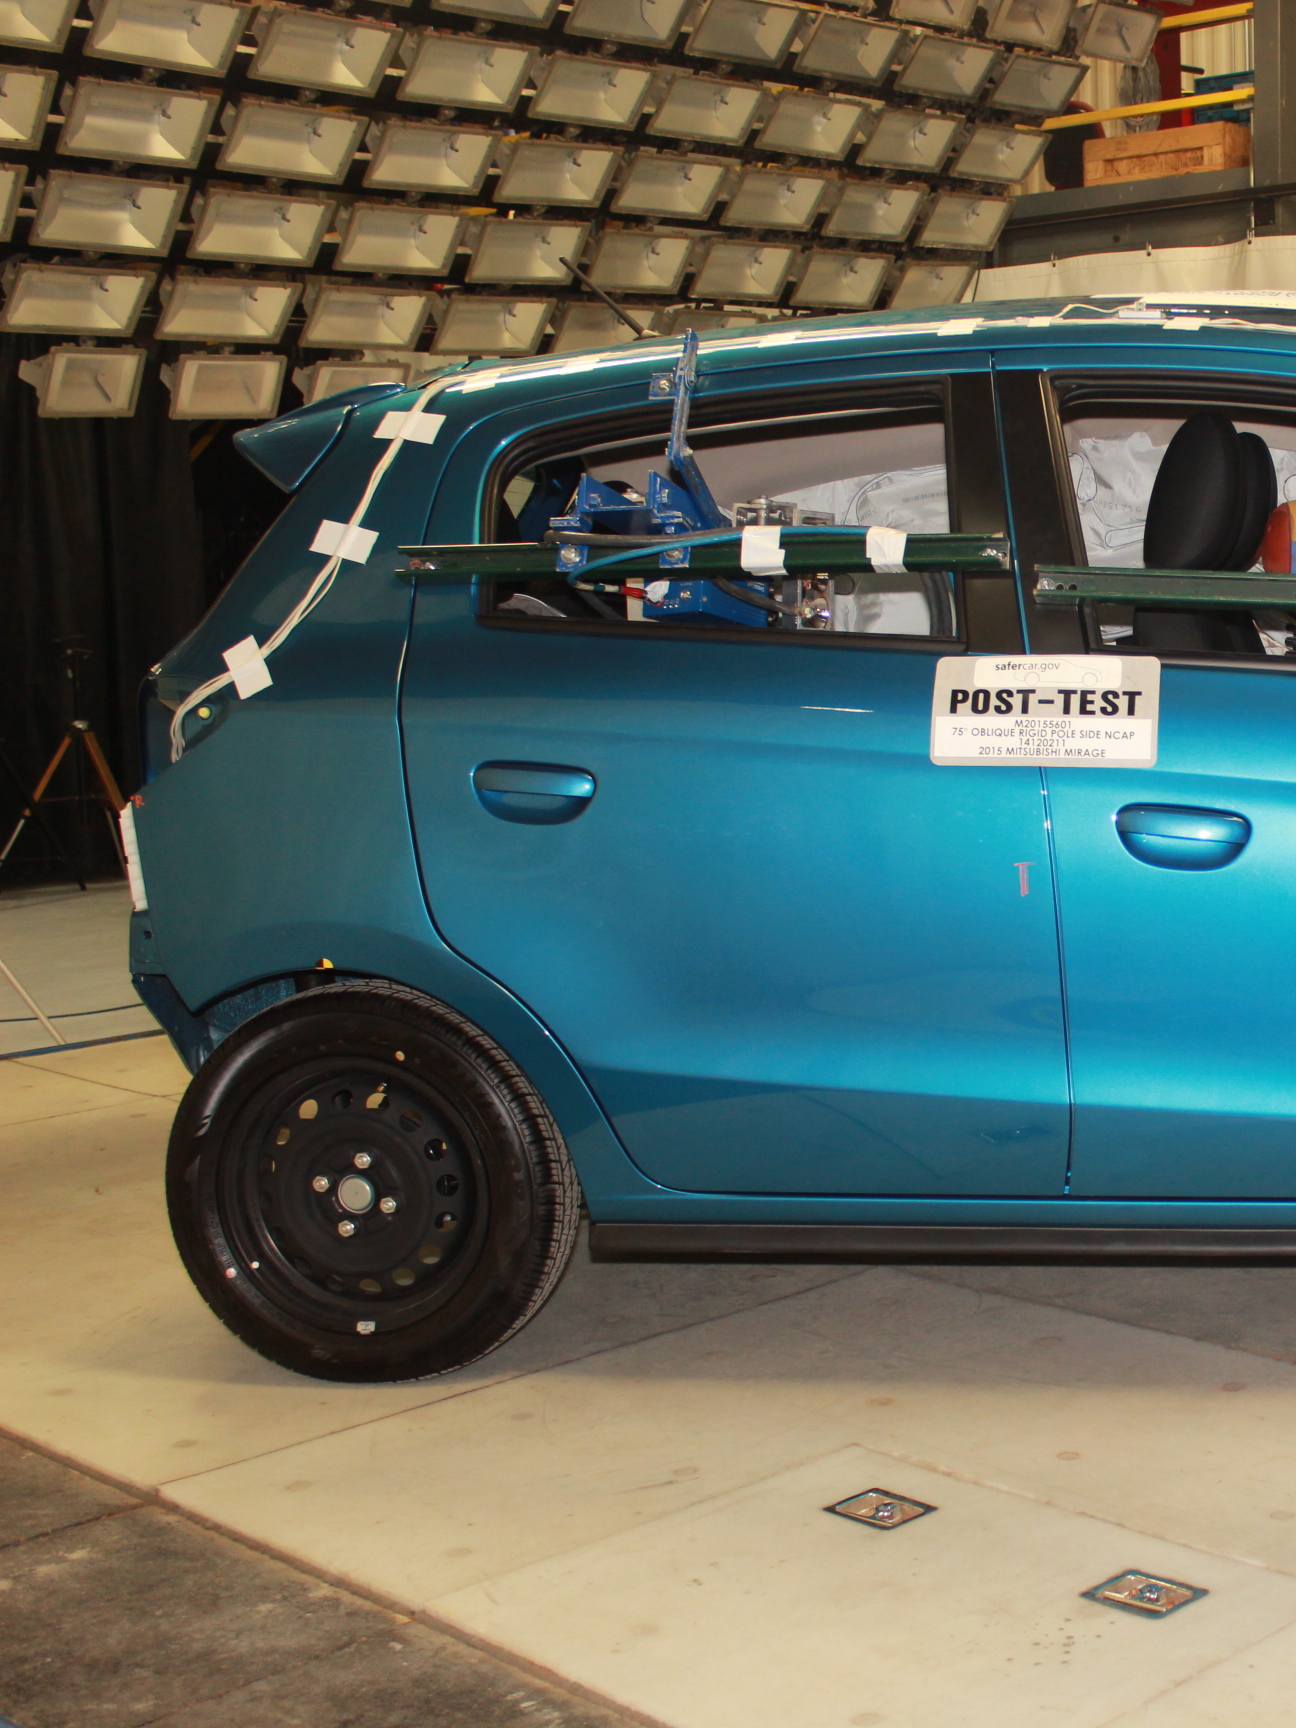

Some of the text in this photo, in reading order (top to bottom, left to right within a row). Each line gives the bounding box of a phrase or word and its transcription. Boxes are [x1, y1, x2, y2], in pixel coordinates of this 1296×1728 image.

[995, 661, 1061, 672] safercar.gov
[949, 689, 1143, 716] POST-TEST
[1014, 719, 1072, 729] M20155601
[952, 727, 1136, 740] 75° OBLIQUE RIGID POLE SIDE NCAP
[1018, 738, 1066, 747] 14120211
[978, 746, 1107, 758] 2015 MITSUBISHI MIRAGE
